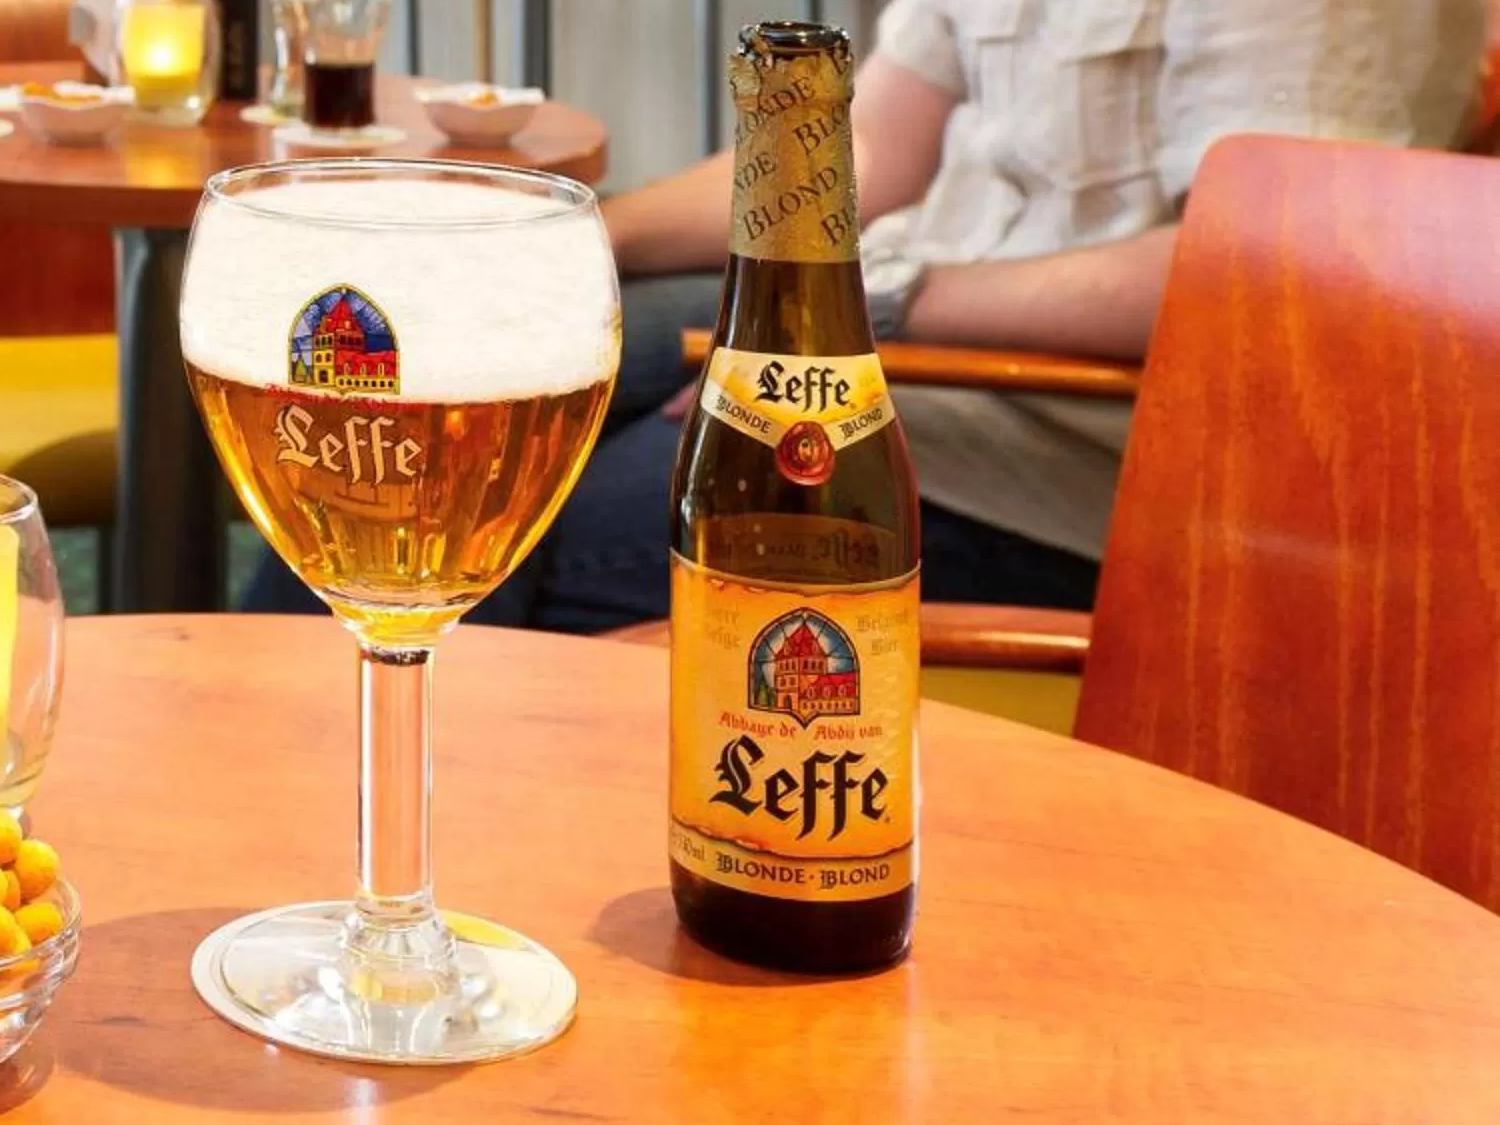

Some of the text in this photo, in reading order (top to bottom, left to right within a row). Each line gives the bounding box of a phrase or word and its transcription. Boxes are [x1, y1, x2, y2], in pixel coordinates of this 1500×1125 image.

[743, 166, 838, 241] BLOND
[755, 360, 851, 413] Leffe
[275, 404, 423, 486] Leffe
[708, 735, 889, 842] Leffe
[715, 850, 806, 885] BLONDE
[819, 863, 889, 889] BLOND
